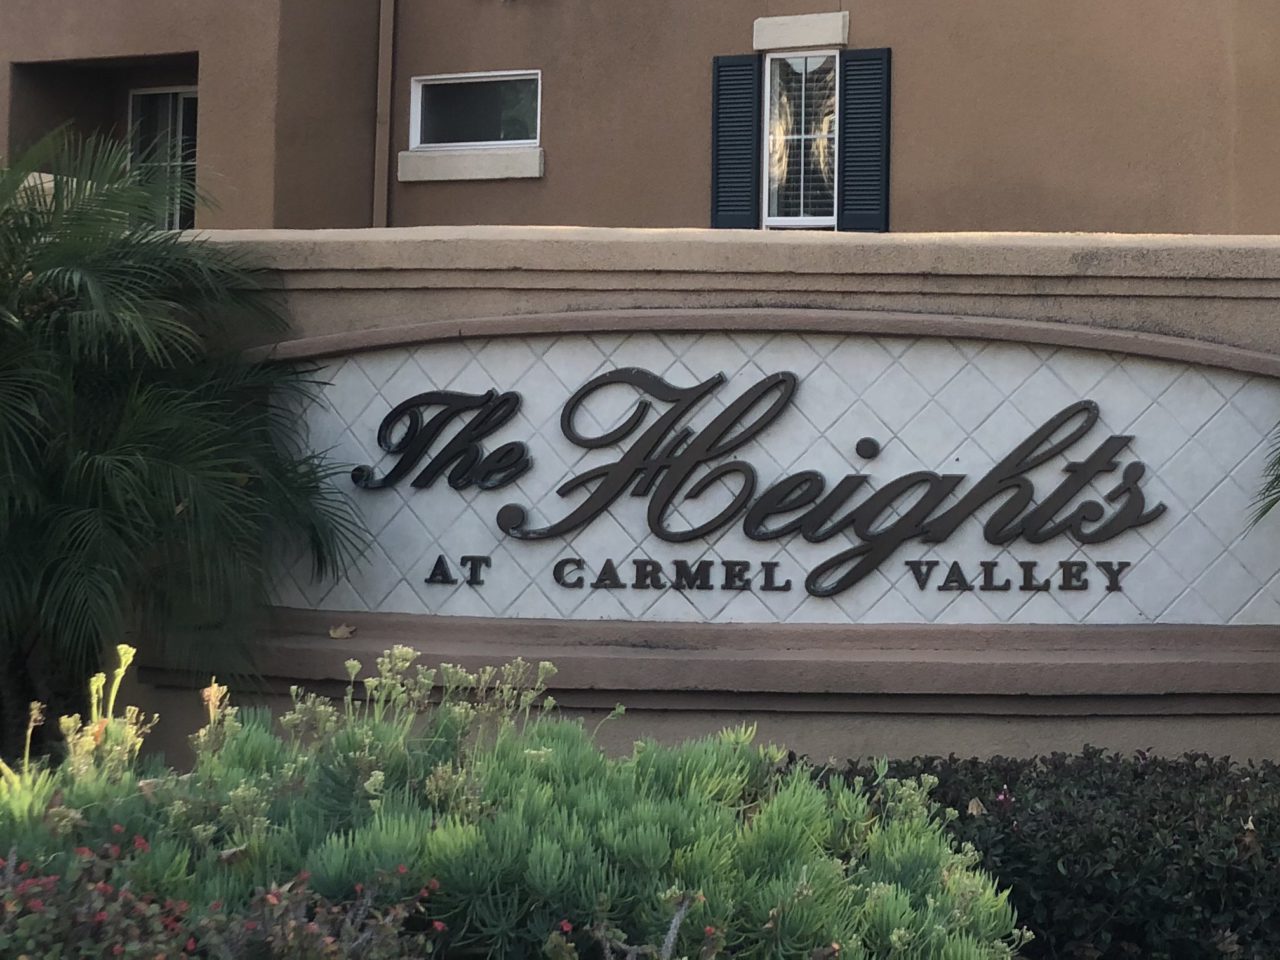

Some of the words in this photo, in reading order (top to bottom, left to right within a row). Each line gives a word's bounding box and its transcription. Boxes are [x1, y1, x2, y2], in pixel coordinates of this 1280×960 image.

[350, 387, 534, 491] The
[496, 366, 1168, 598] Heights
[424, 554, 492, 586] AT
[552, 557, 792, 591] CARMEL
[904, 560, 1132, 592] VALLEY
